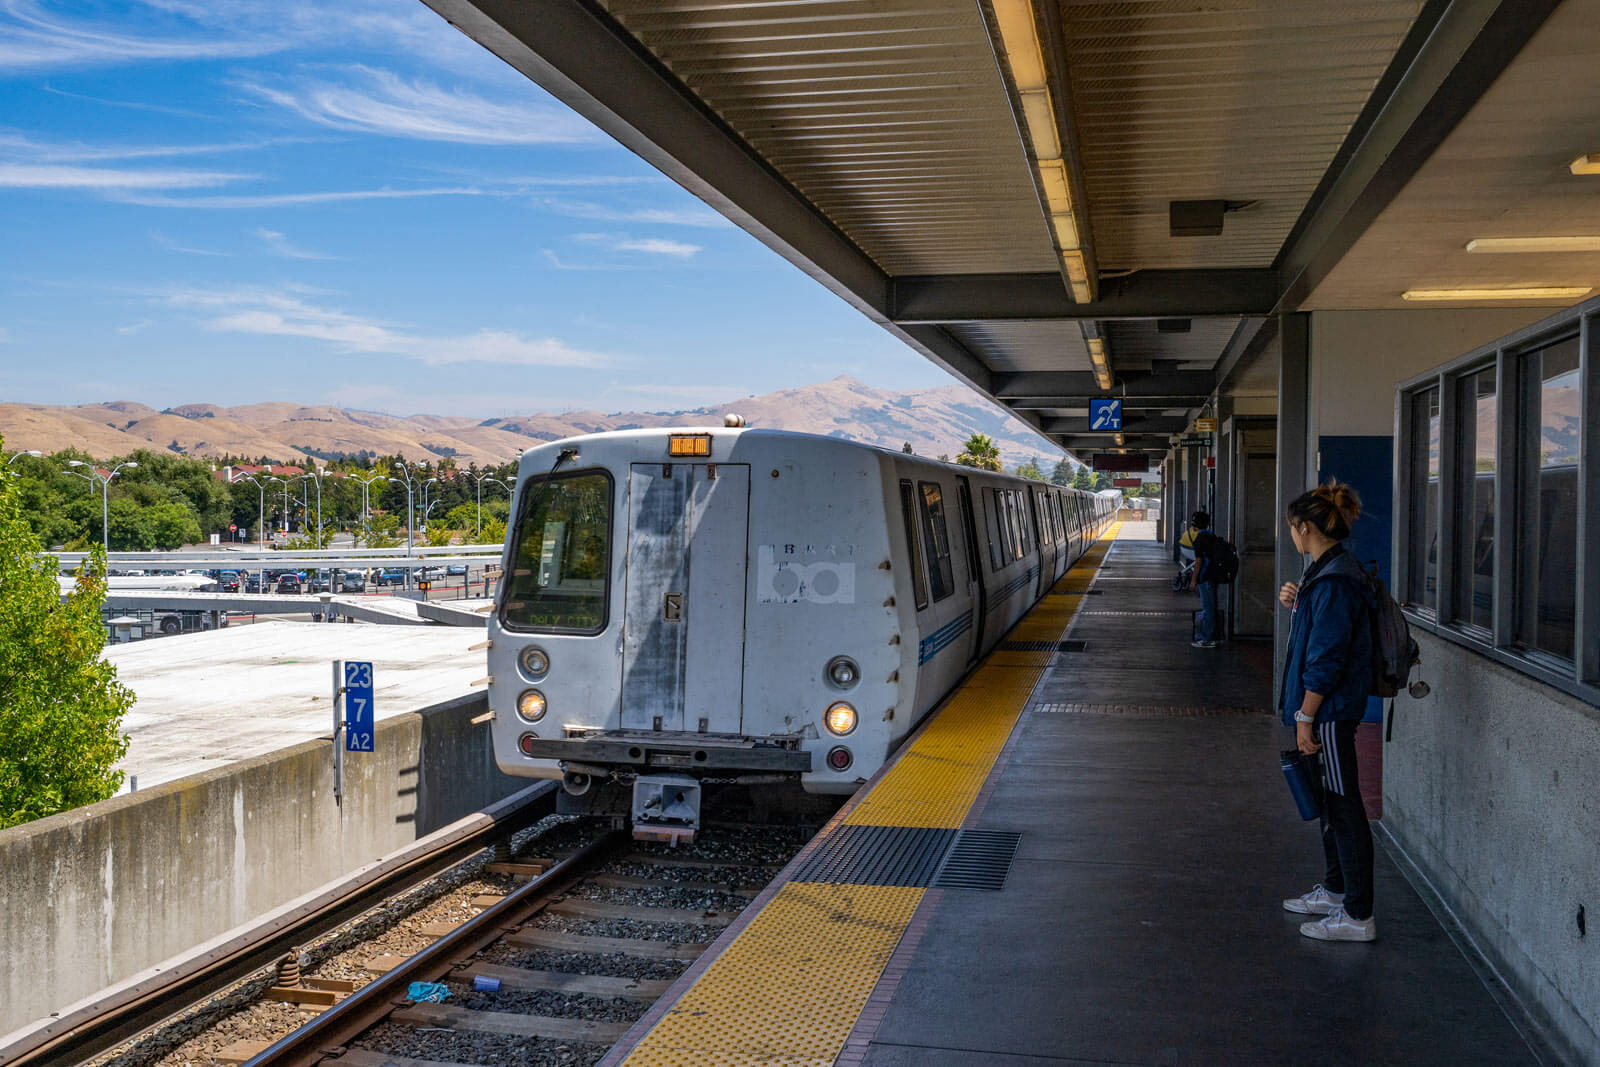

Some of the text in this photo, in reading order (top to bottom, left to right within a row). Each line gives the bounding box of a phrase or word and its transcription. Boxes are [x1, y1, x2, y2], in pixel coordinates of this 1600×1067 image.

[346, 663, 372, 688] 23
[353, 698, 367, 722] 7
[350, 732, 371, 750] A2
